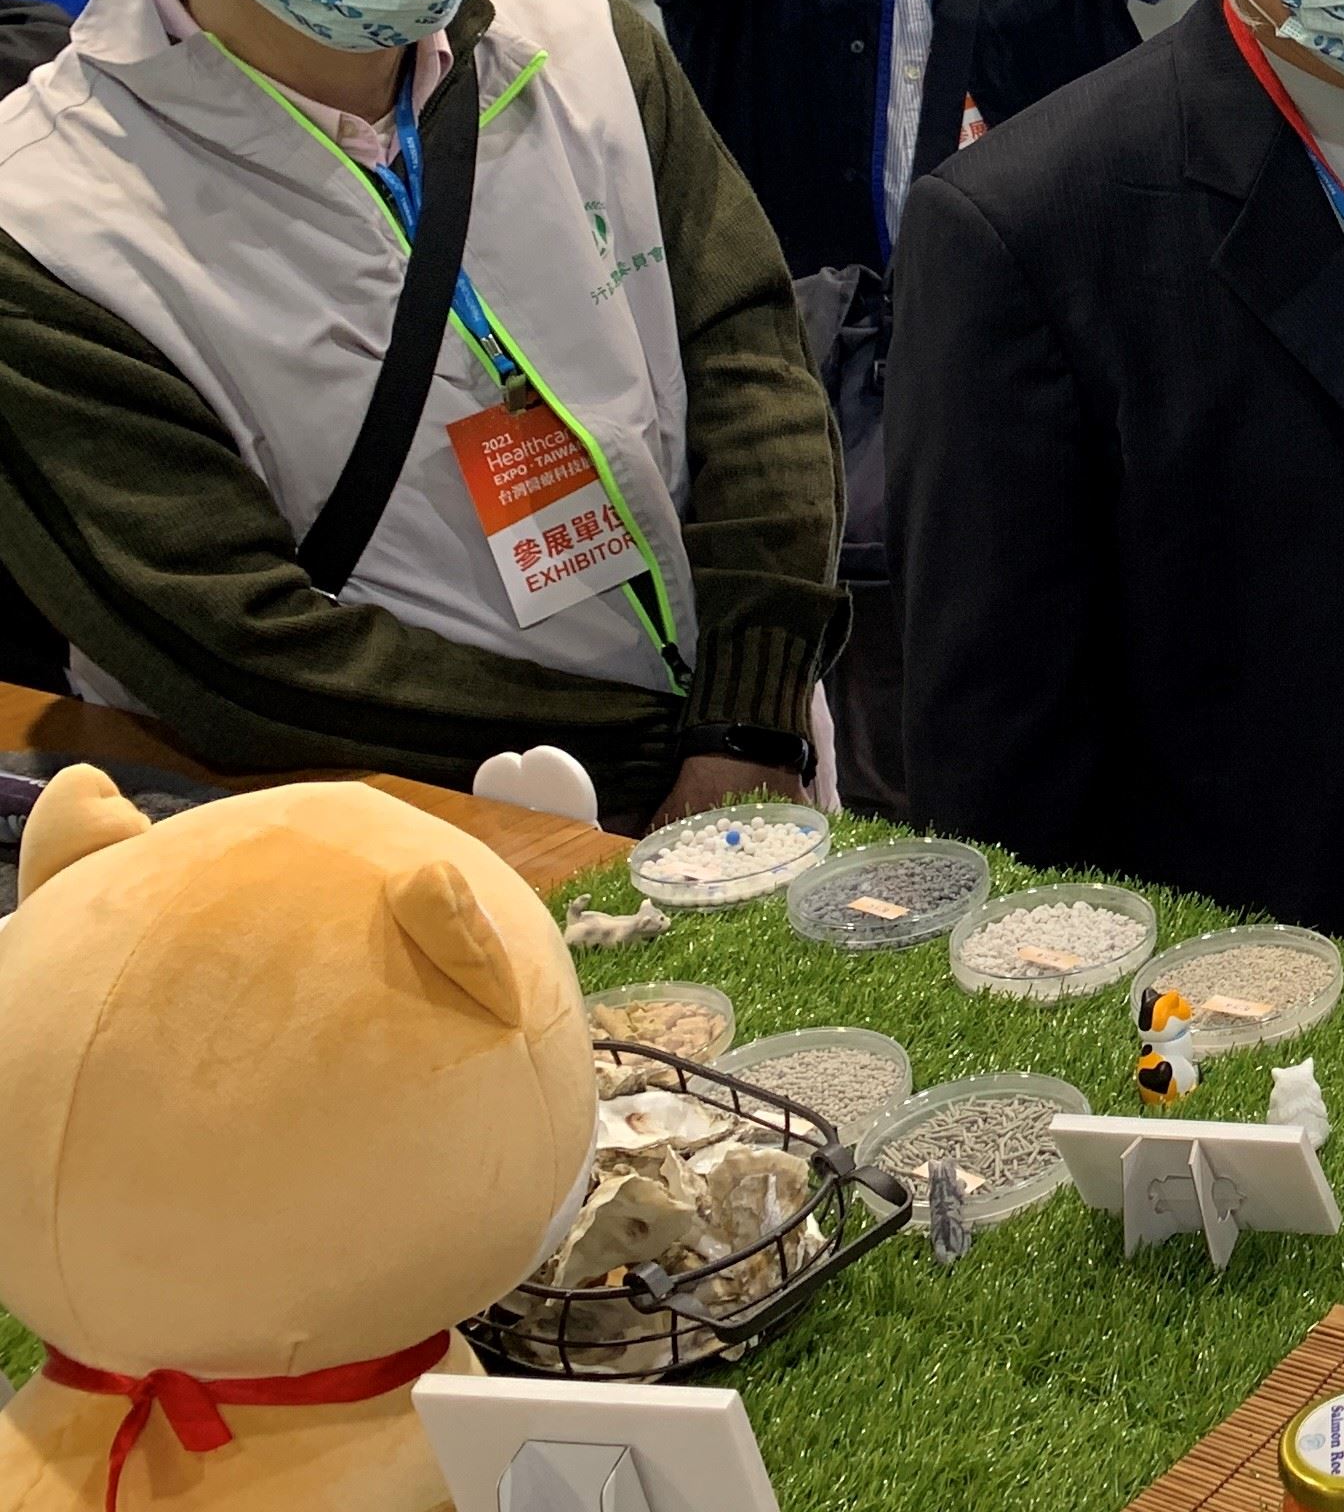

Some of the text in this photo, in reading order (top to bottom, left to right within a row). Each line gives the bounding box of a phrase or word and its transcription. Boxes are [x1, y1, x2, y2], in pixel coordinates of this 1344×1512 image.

[482, 433, 514, 455] 2021
[492, 463, 528, 486] EXPO
[525, 531, 638, 593] EXHIBITOR
[1330, 1404, 1344, 1475] Salmon Roe
